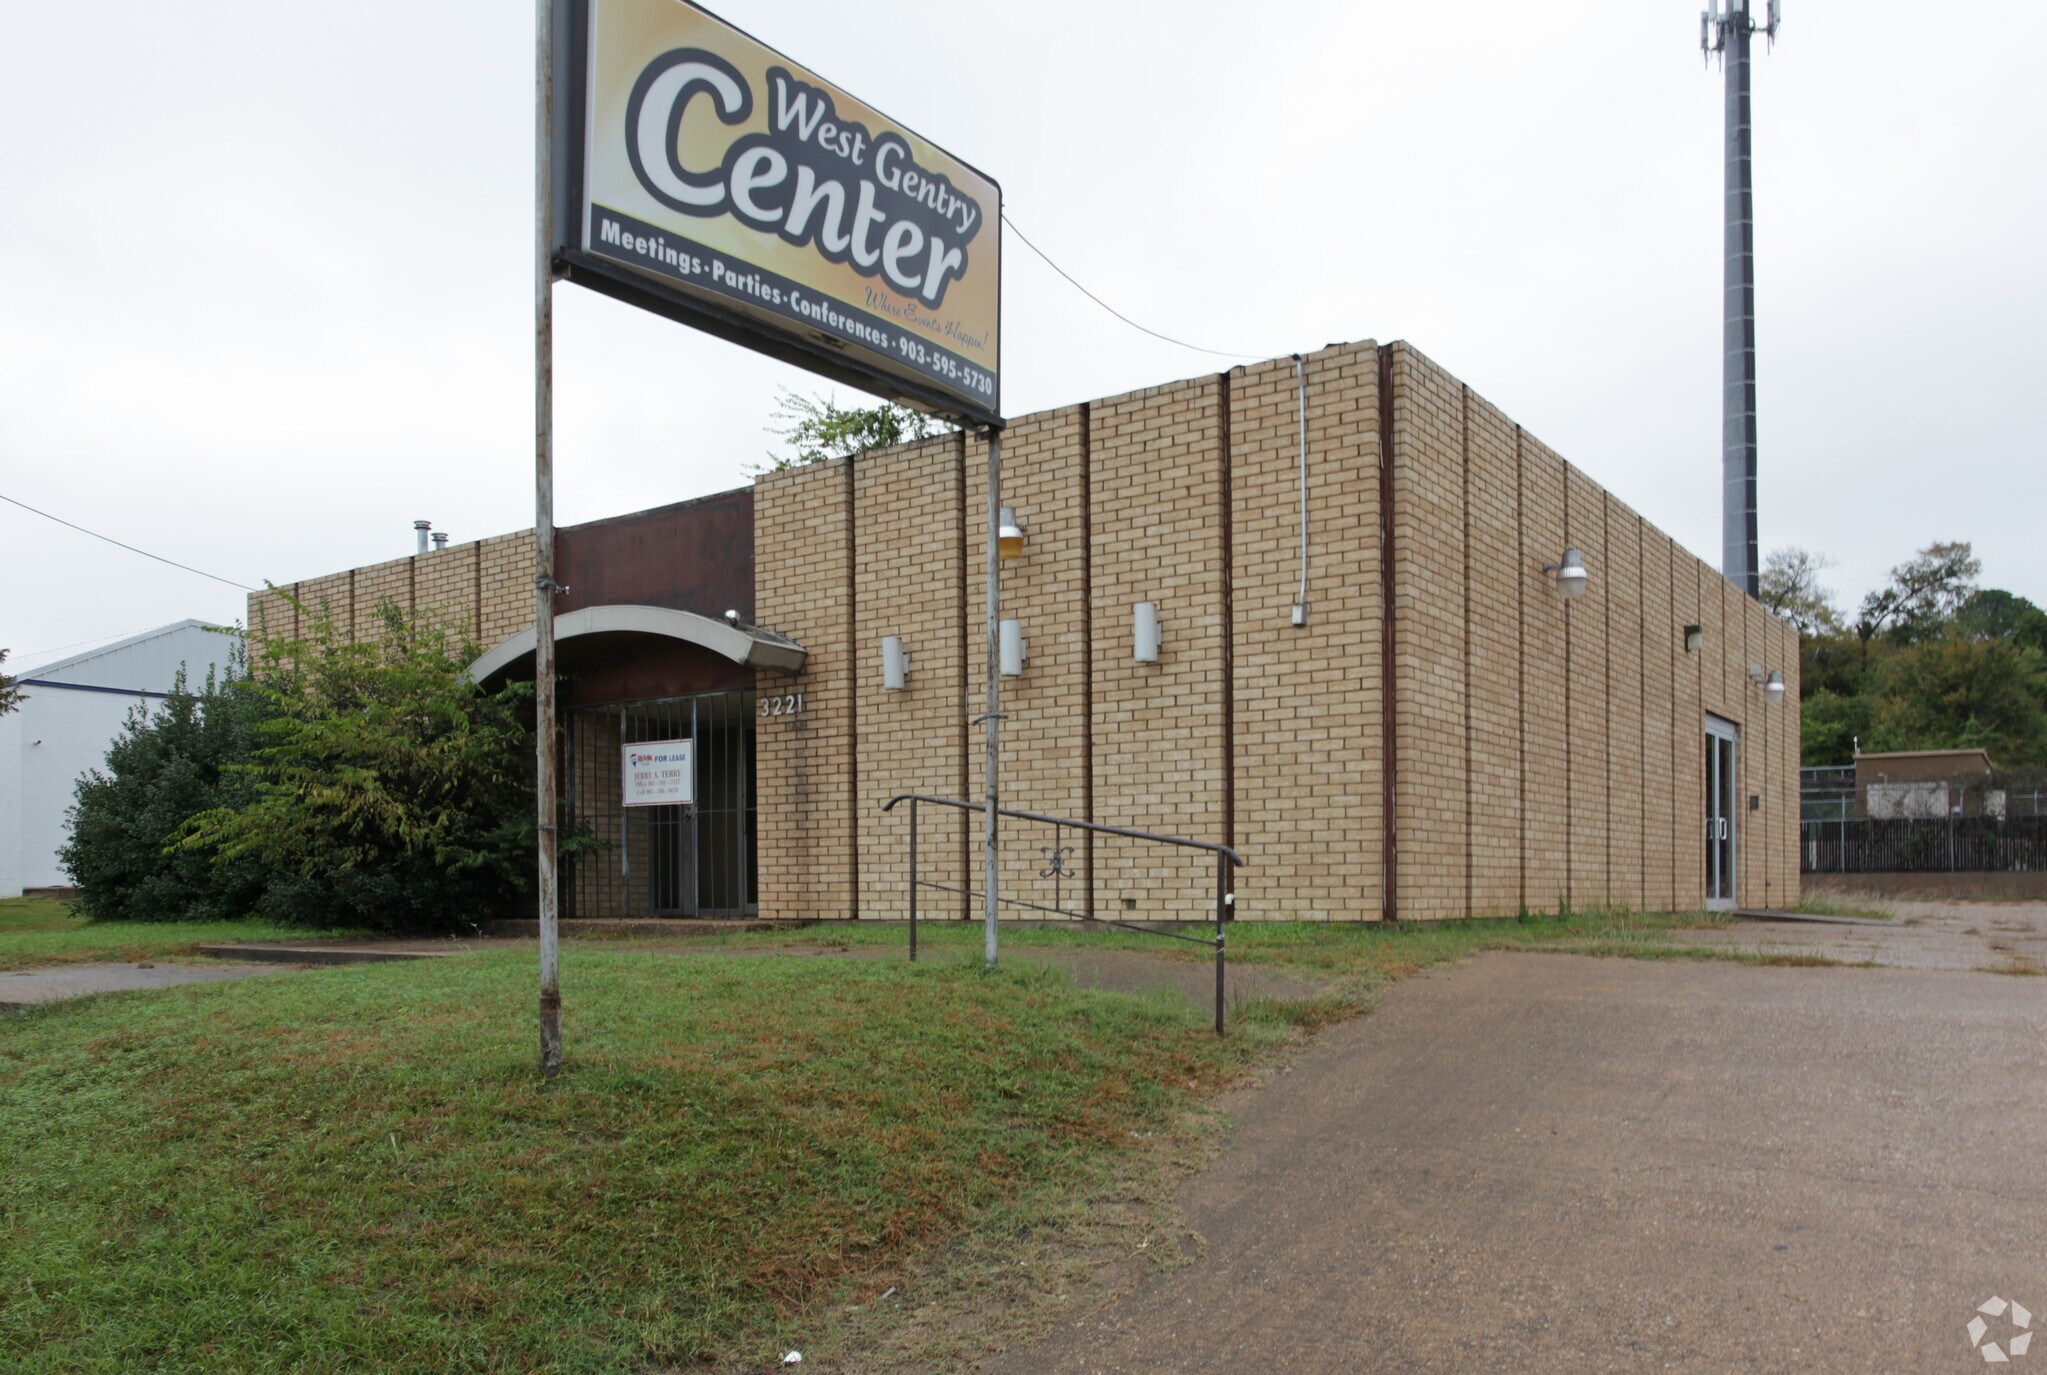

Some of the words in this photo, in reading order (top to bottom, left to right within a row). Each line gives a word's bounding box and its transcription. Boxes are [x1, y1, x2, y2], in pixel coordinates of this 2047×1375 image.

[637, 61, 963, 300] Center
[776, 77, 866, 165] West
[876, 141, 976, 232] Gentry
[790, 290, 888, 348] Conferences
[899, 336, 993, 396] 903-595-5730
[864, 286, 901, 316] Where
[903, 303, 941, 332] Events
[944, 320, 989, 351] Happen!
[760, 694, 802, 717] 3221
[669, 754, 686, 762] LEASE
